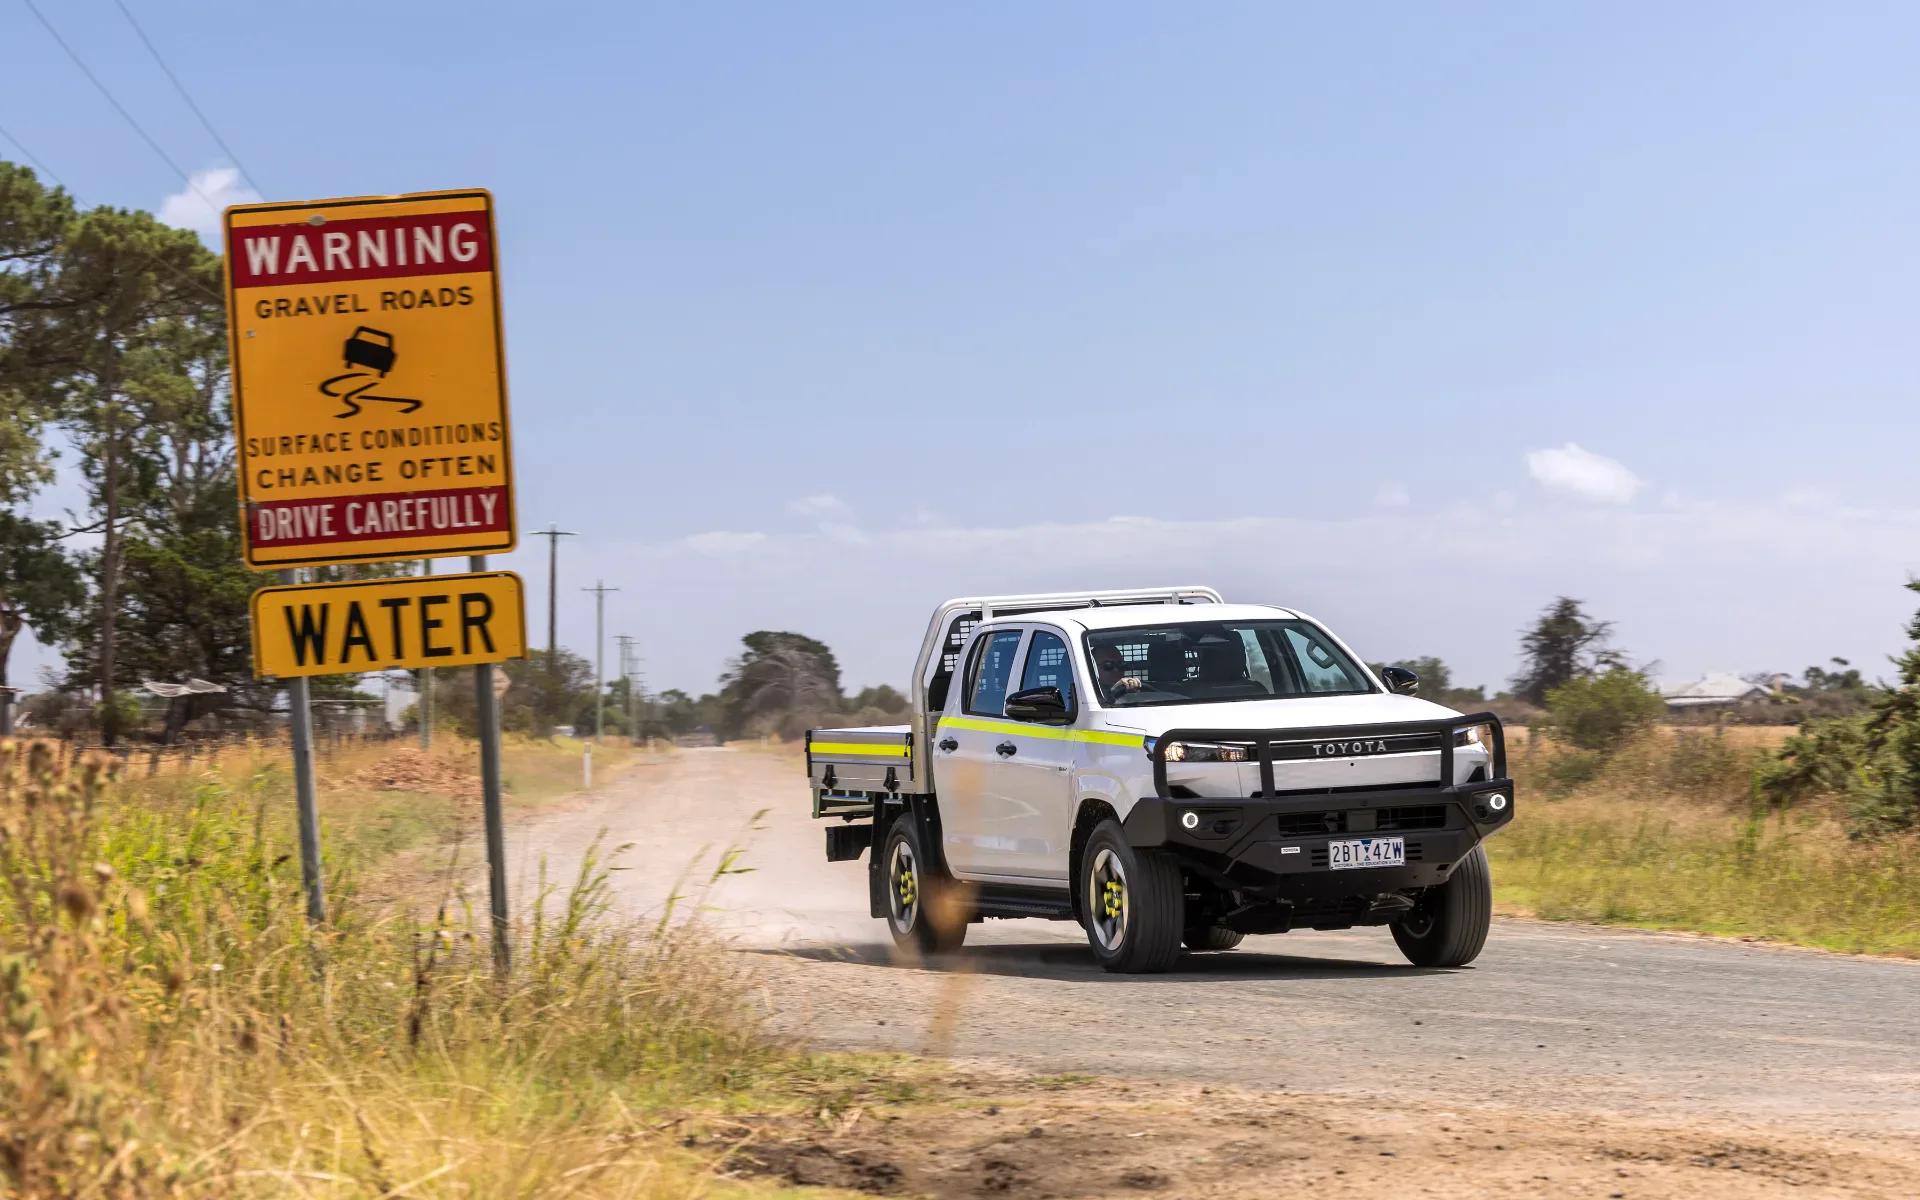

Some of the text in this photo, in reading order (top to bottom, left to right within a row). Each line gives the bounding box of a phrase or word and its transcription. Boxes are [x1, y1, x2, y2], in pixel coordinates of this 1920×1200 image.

[244, 222, 479, 276] WARNING
[255, 286, 474, 319] GRAVEL ROADS
[247, 421, 501, 458] SURFACE CONDITIONS
[256, 454, 497, 489] CHANGE OFTEN
[258, 493, 498, 541] DRIVE CAREFULLY
[282, 592, 497, 667] WATER
[1312, 740, 1387, 756] TOYOTA
[1332, 842, 1402, 863] 2BT 4ZW
